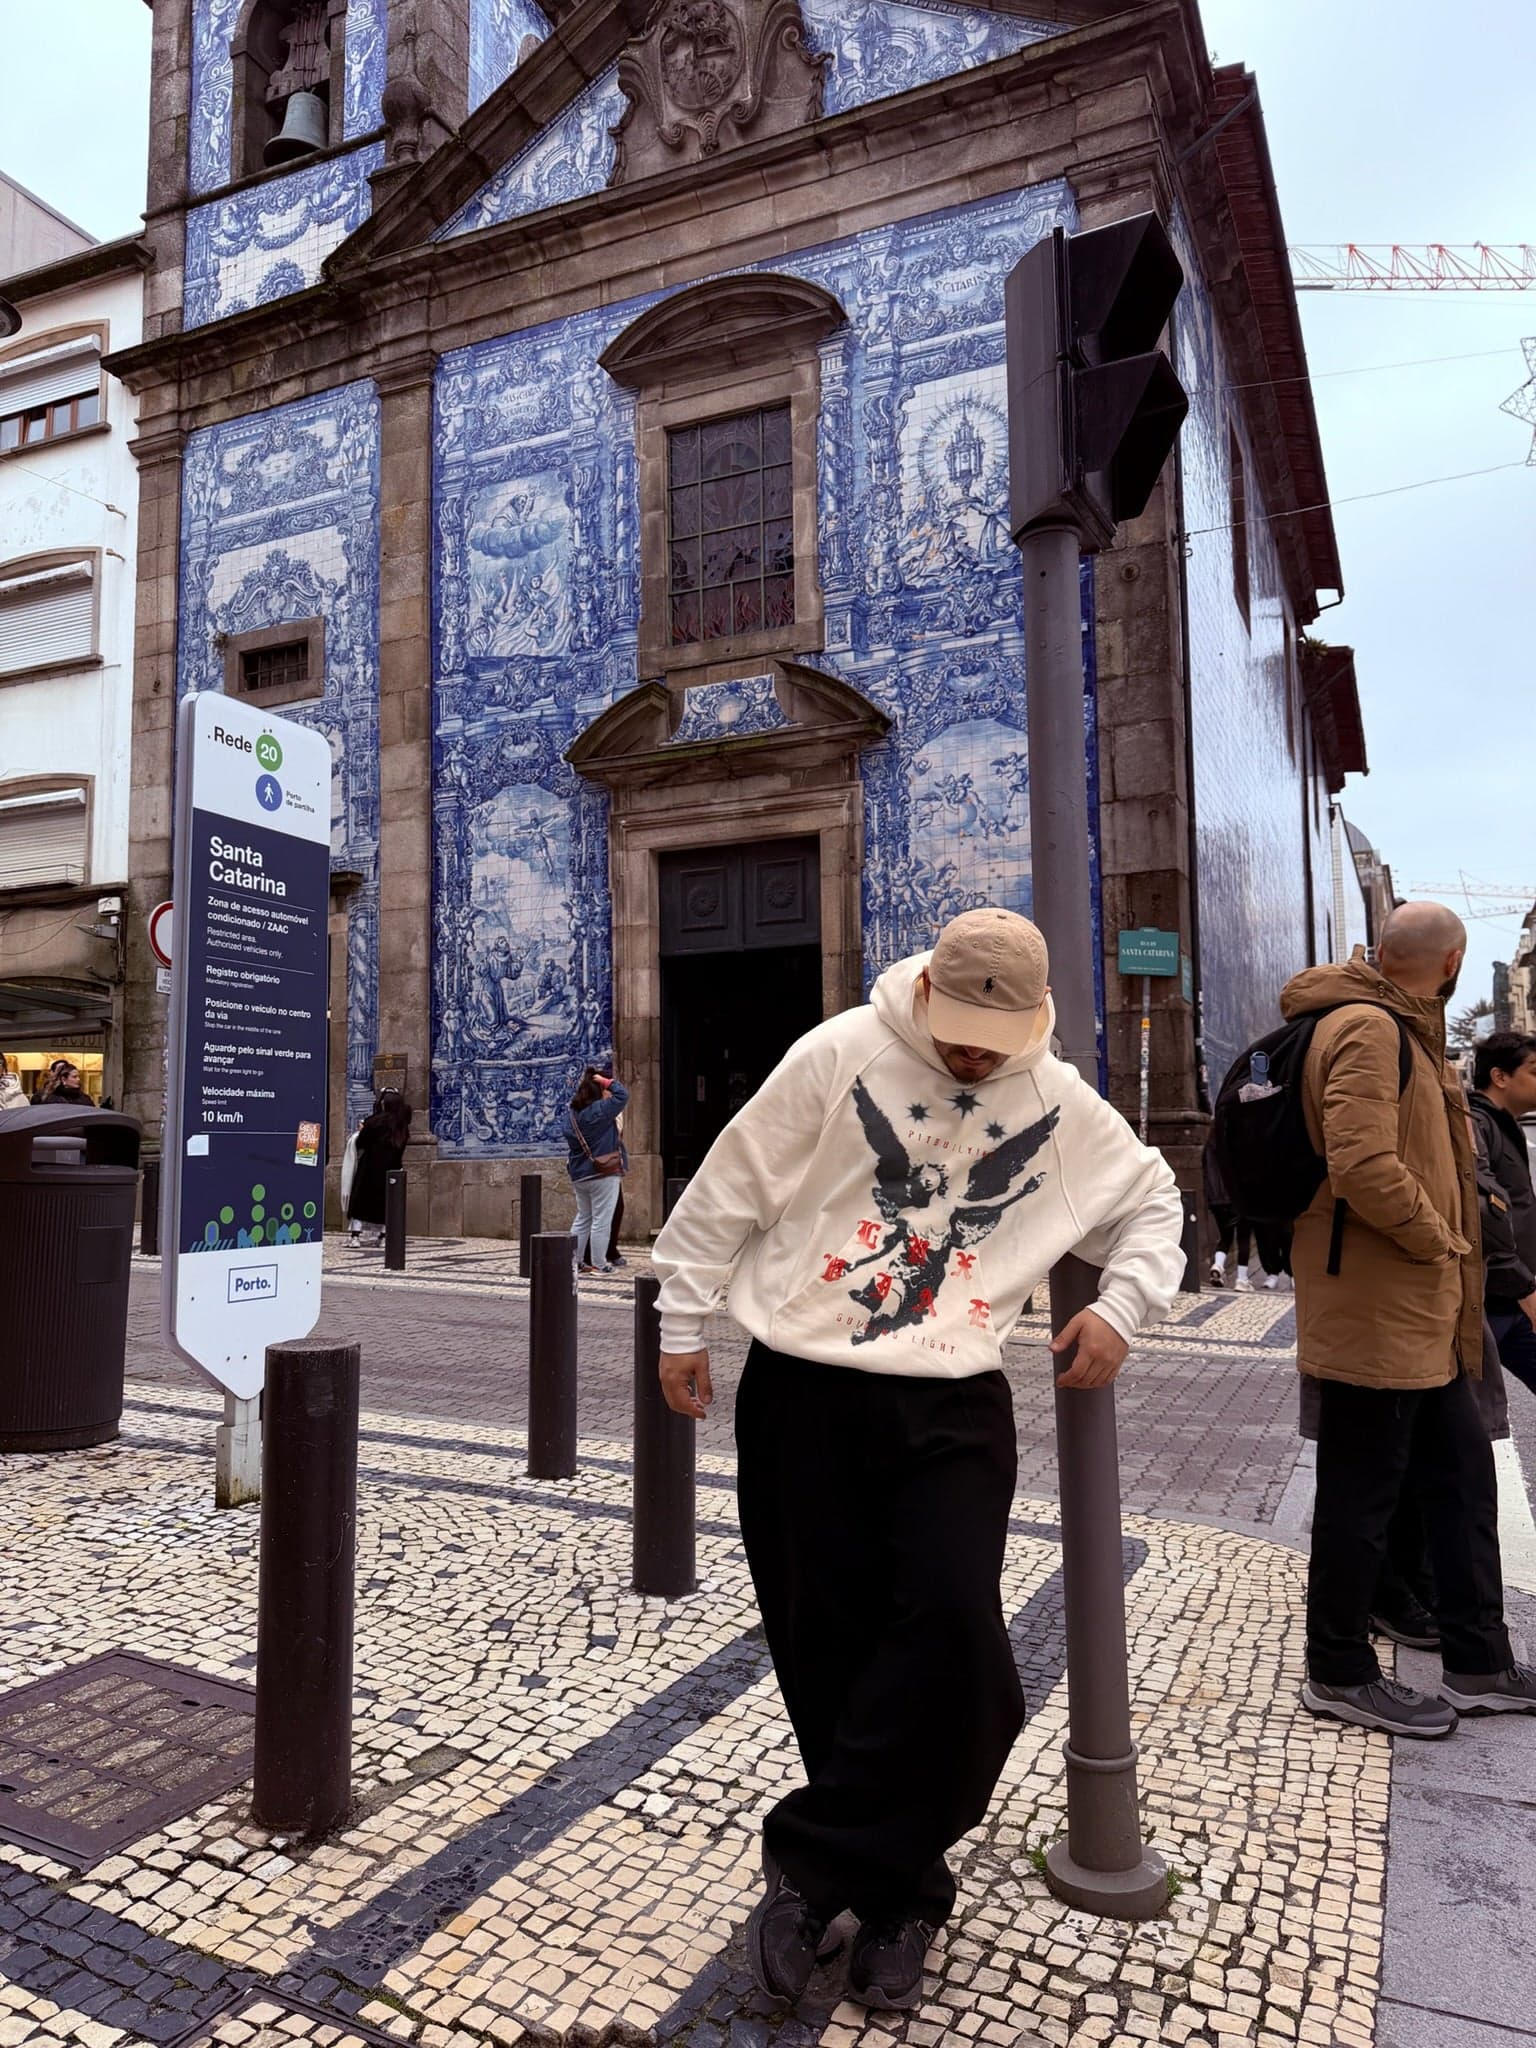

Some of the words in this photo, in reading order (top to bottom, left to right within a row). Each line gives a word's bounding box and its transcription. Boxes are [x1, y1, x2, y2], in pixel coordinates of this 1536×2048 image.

[214, 726, 252, 753] Rede
[261, 743, 278, 762] 20
[210, 836, 263, 868] Santa
[209, 861, 286, 896] Catarina
[208, 896, 229, 909] Zona
[230, 901, 241, 911] de
[242, 905, 270, 918] acesso
[271, 911, 309, 926] automóvel
[207, 912, 261, 929] condicionado
[267, 921, 289, 934] ZAAC
[207, 926, 240, 940] Restricted
[1121, 948, 1142, 956] SANTA
[1143, 948, 1175, 958] CATARINA
[240, 971, 281, 985] obrigatório
[204, 1010, 216, 1019] da
[216, 1011, 228, 1020] via
[205, 997, 243, 1010] Posicione
[278, 1008, 288, 1016] no
[289, 1009, 312, 1019] centro
[204, 1041, 237, 1054] Aguarde
[238, 1045, 254, 1055] pelo
[256, 1046, 273, 1056] sinal
[274, 1049, 294, 1058] verde
[295, 1051, 311, 1060] para
[203, 1055, 235, 1066] avançar
[202, 1086, 245, 1097] Velocidade
[246, 1088, 275, 1098] máxima
[202, 1110, 215, 1123] 10
[216, 1110, 244, 1123] km/h
[235, 1277, 271, 1293] Porto.
